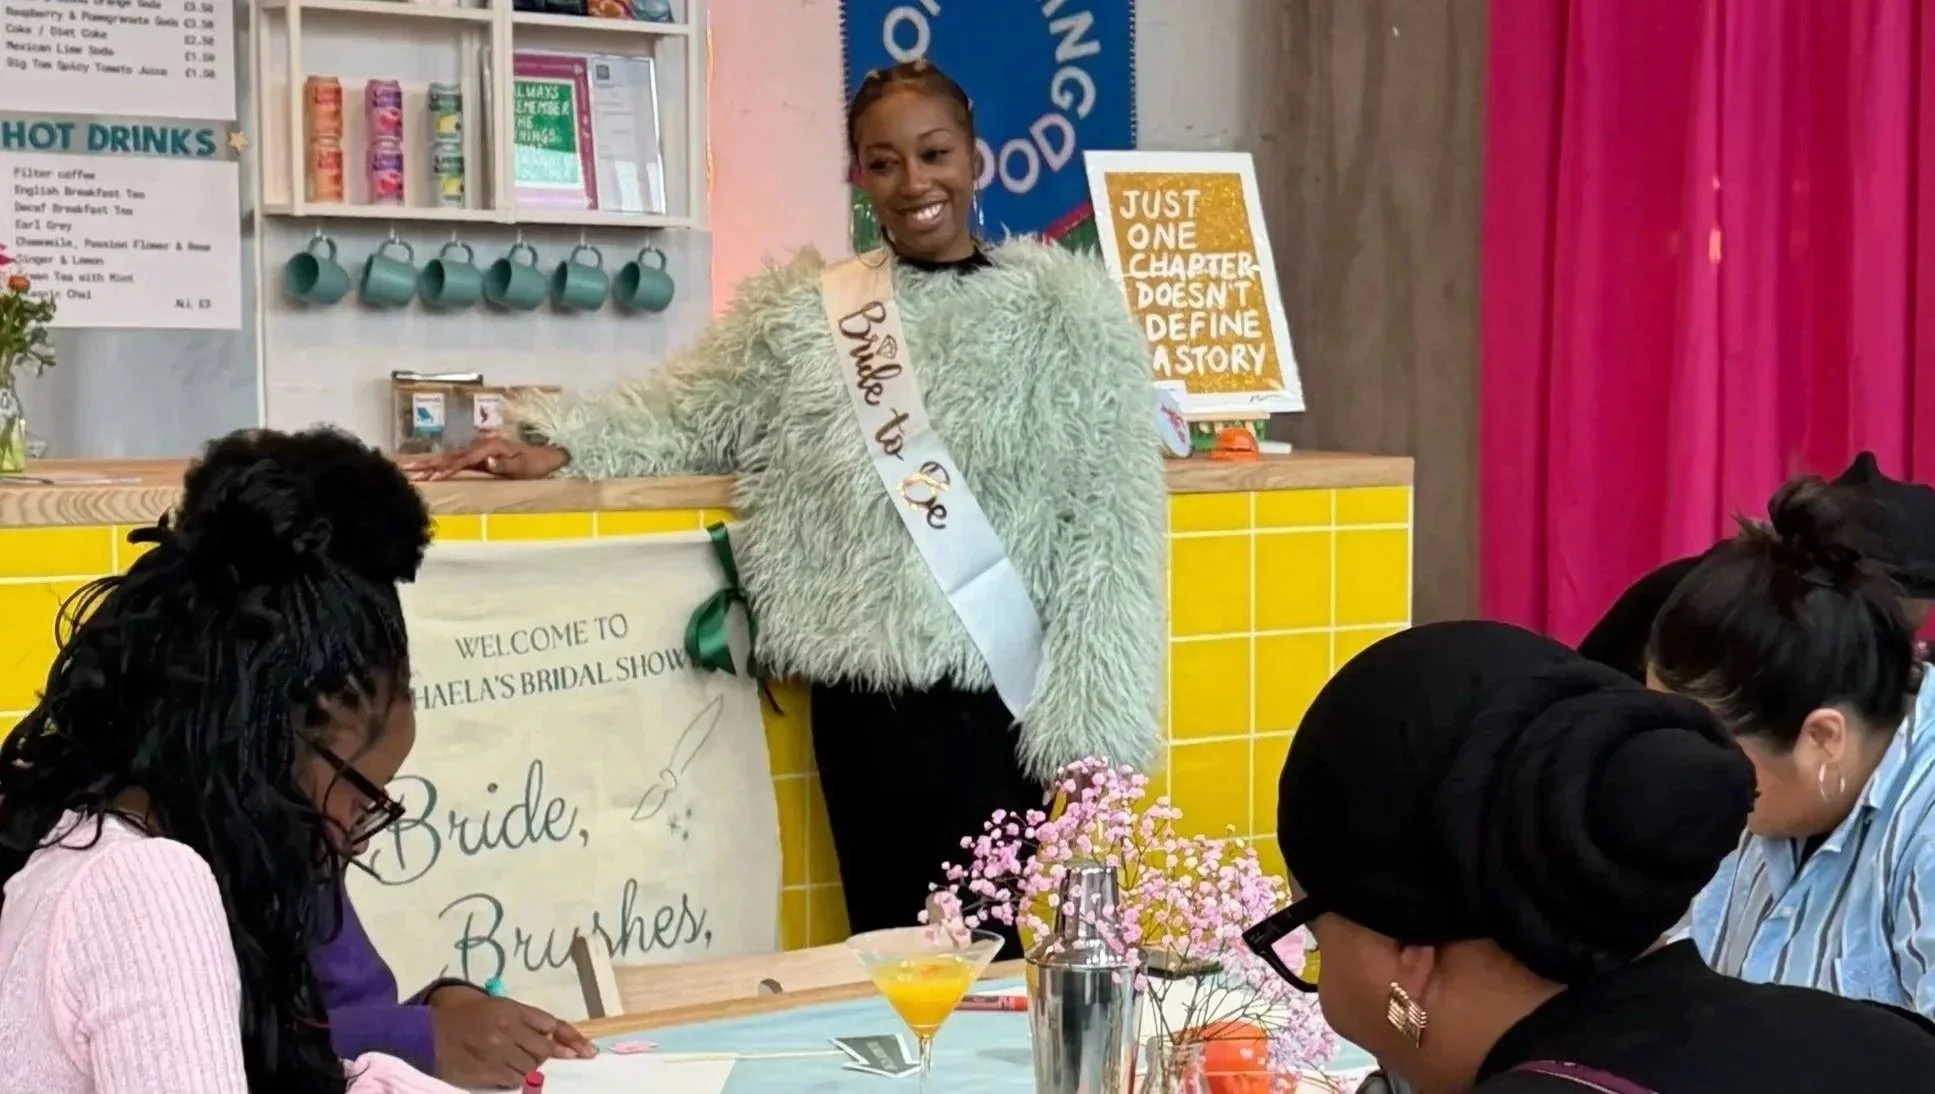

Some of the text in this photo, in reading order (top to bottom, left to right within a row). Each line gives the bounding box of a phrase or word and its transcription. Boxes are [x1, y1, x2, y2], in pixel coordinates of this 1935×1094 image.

[5, 6, 63, 22] Raspberry
[81, 10, 150, 25] Pomegranate
[5, 23, 32, 34] Coke
[50, 25, 76, 38] Diet
[81, 28, 108, 39] Coke
[6, 41, 52, 52] Mexican
[56, 42, 83, 54] Lime
[88, 44, 115, 56] Soda
[6, 57, 27, 70] Big
[32, 58, 52, 69] Tom
[57, 60, 90, 74] Spicy
[95, 61, 133, 75] Tomato
[514, 84, 559, 99] LWAYS
[514, 99, 570, 116] EMEMBER
[2, 121, 217, 157] HOT DRINKS
[14, 166, 96, 181] Filter coffee
[14, 183, 146, 199] English Breakfast Tea
[14, 201, 134, 216] Decaf Breakfast Tea
[1120, 189, 1201, 220] JUST
[15, 219, 73, 233] Earl Grey
[84, 238, 128, 249] Passion
[133, 239, 169, 252] Flower
[1127, 221, 1199, 251] ONE
[72, 255, 105, 266] Lemon
[1129, 251, 1256, 282] CHAPTER
[54, 270, 74, 282] Tea
[78, 272, 105, 283] with
[109, 272, 134, 284] Mint
[66, 288, 91, 300] Chai
[1136, 280, 1252, 310] DOESN'T
[1145, 309, 1263, 342] DEFINE
[1152, 342, 1266, 377] A STORY
[838, 301, 951, 529] Bride to Be
[455, 612, 630, 660] WELCOME TO
[409, 645, 688, 712] HAELA'S BRIDAL SHOW
[370, 759, 590, 886] Bride,
[438, 877, 714, 977] Brushes,
